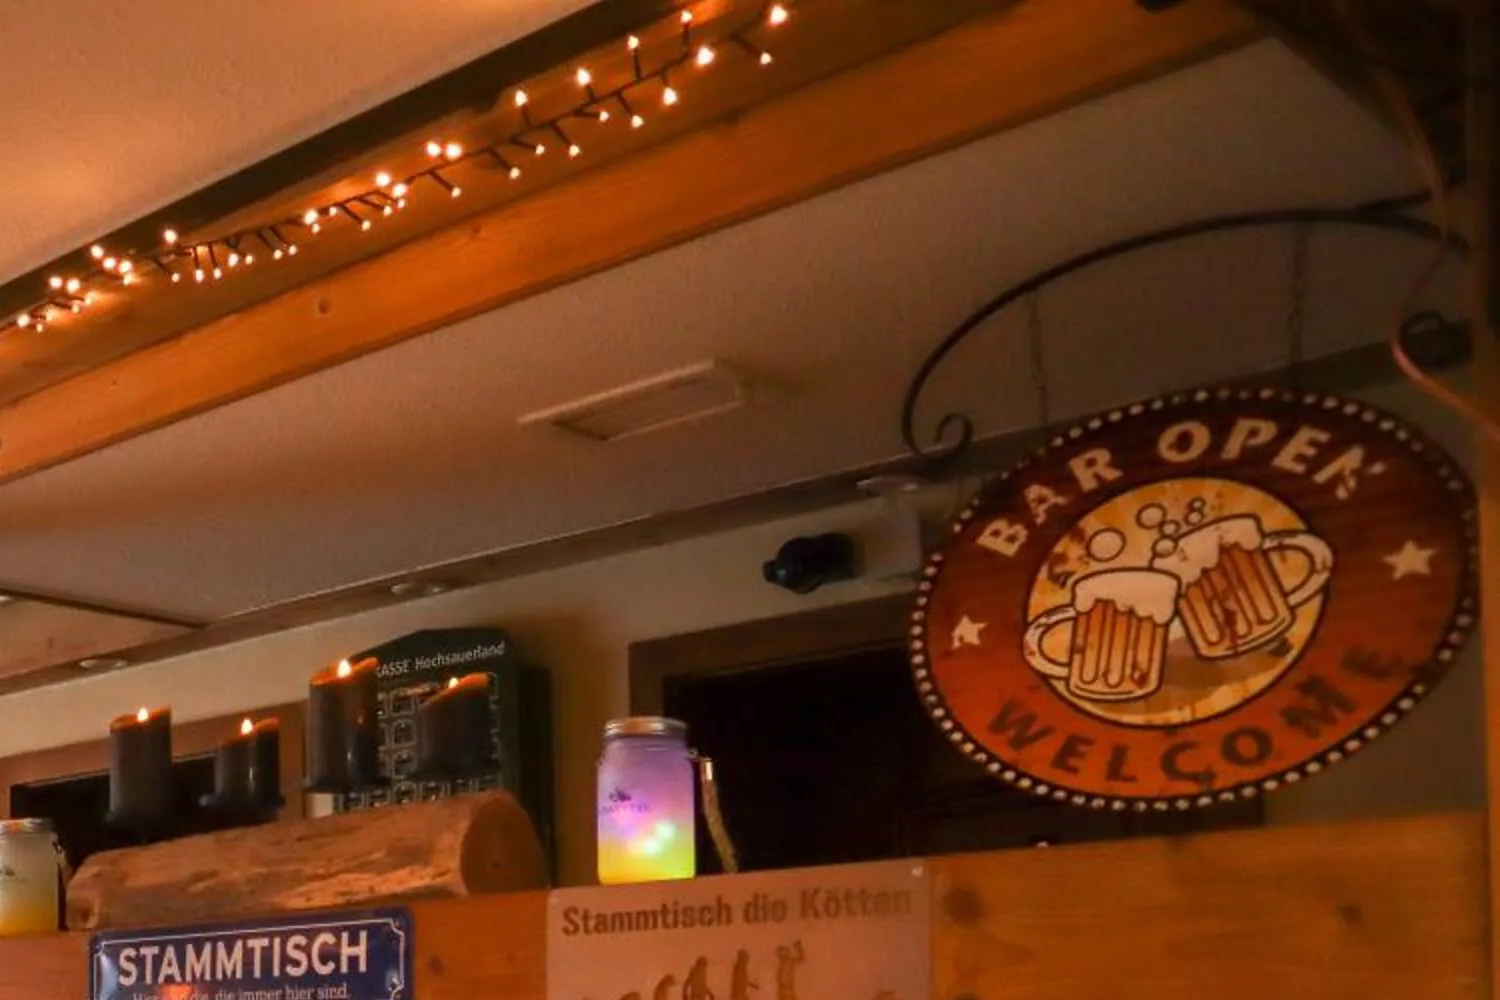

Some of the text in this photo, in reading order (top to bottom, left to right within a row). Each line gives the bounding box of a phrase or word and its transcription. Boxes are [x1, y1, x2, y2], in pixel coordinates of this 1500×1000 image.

[976, 418, 1387, 557] BAR OPEN
[414, 640, 506, 670] Hochsauerland
[986, 643, 1397, 785] WELCOME
[561, 896, 732, 936] Stammtisch
[743, 892, 789, 924] die
[118, 930, 368, 987] STAMMTISCH
[285, 984, 314, 1000] hier
